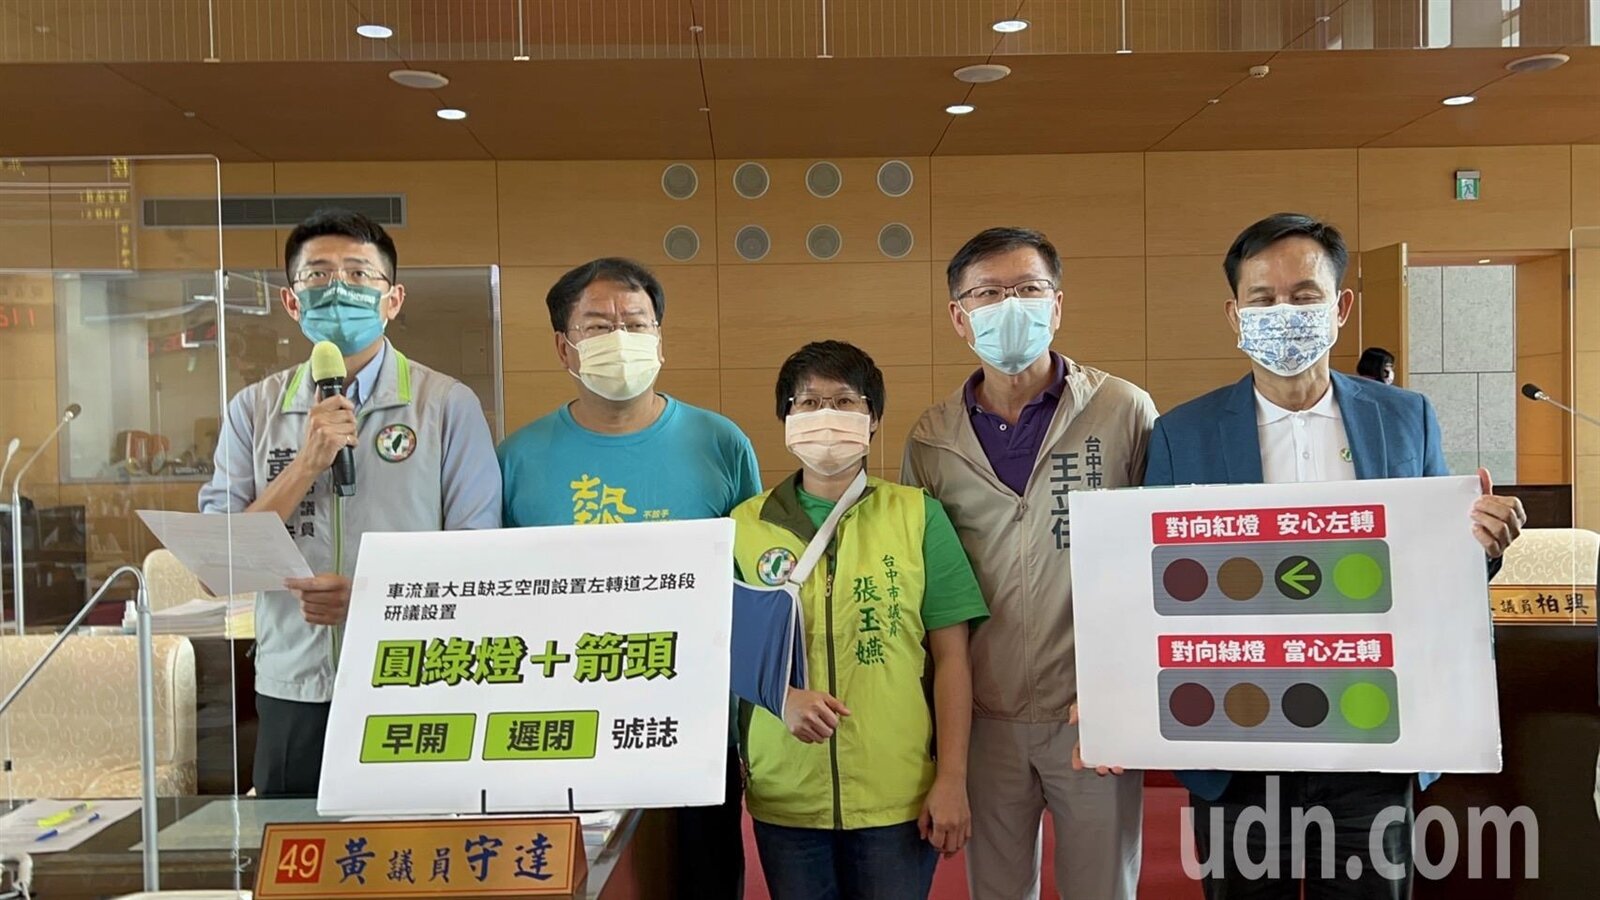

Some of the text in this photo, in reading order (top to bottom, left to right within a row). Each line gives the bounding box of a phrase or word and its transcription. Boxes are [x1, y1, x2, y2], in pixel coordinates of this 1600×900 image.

[1165, 510, 1375, 538] 對向紅燈 安心左轉
[386, 572, 696, 600] 車流量大且缺乏空間設置左轉道之路段
[882, 555, 901, 637] 台中市議員
[384, 604, 457, 621] 研議設置
[853, 576, 885, 665] 張玉嬿
[1171, 639, 1382, 663] 對向綠燈 當心左轉
[382, 723, 448, 754] 早開
[612, 717, 679, 750] 號誌
[278, 833, 553, 884] 49 黃議員守達
